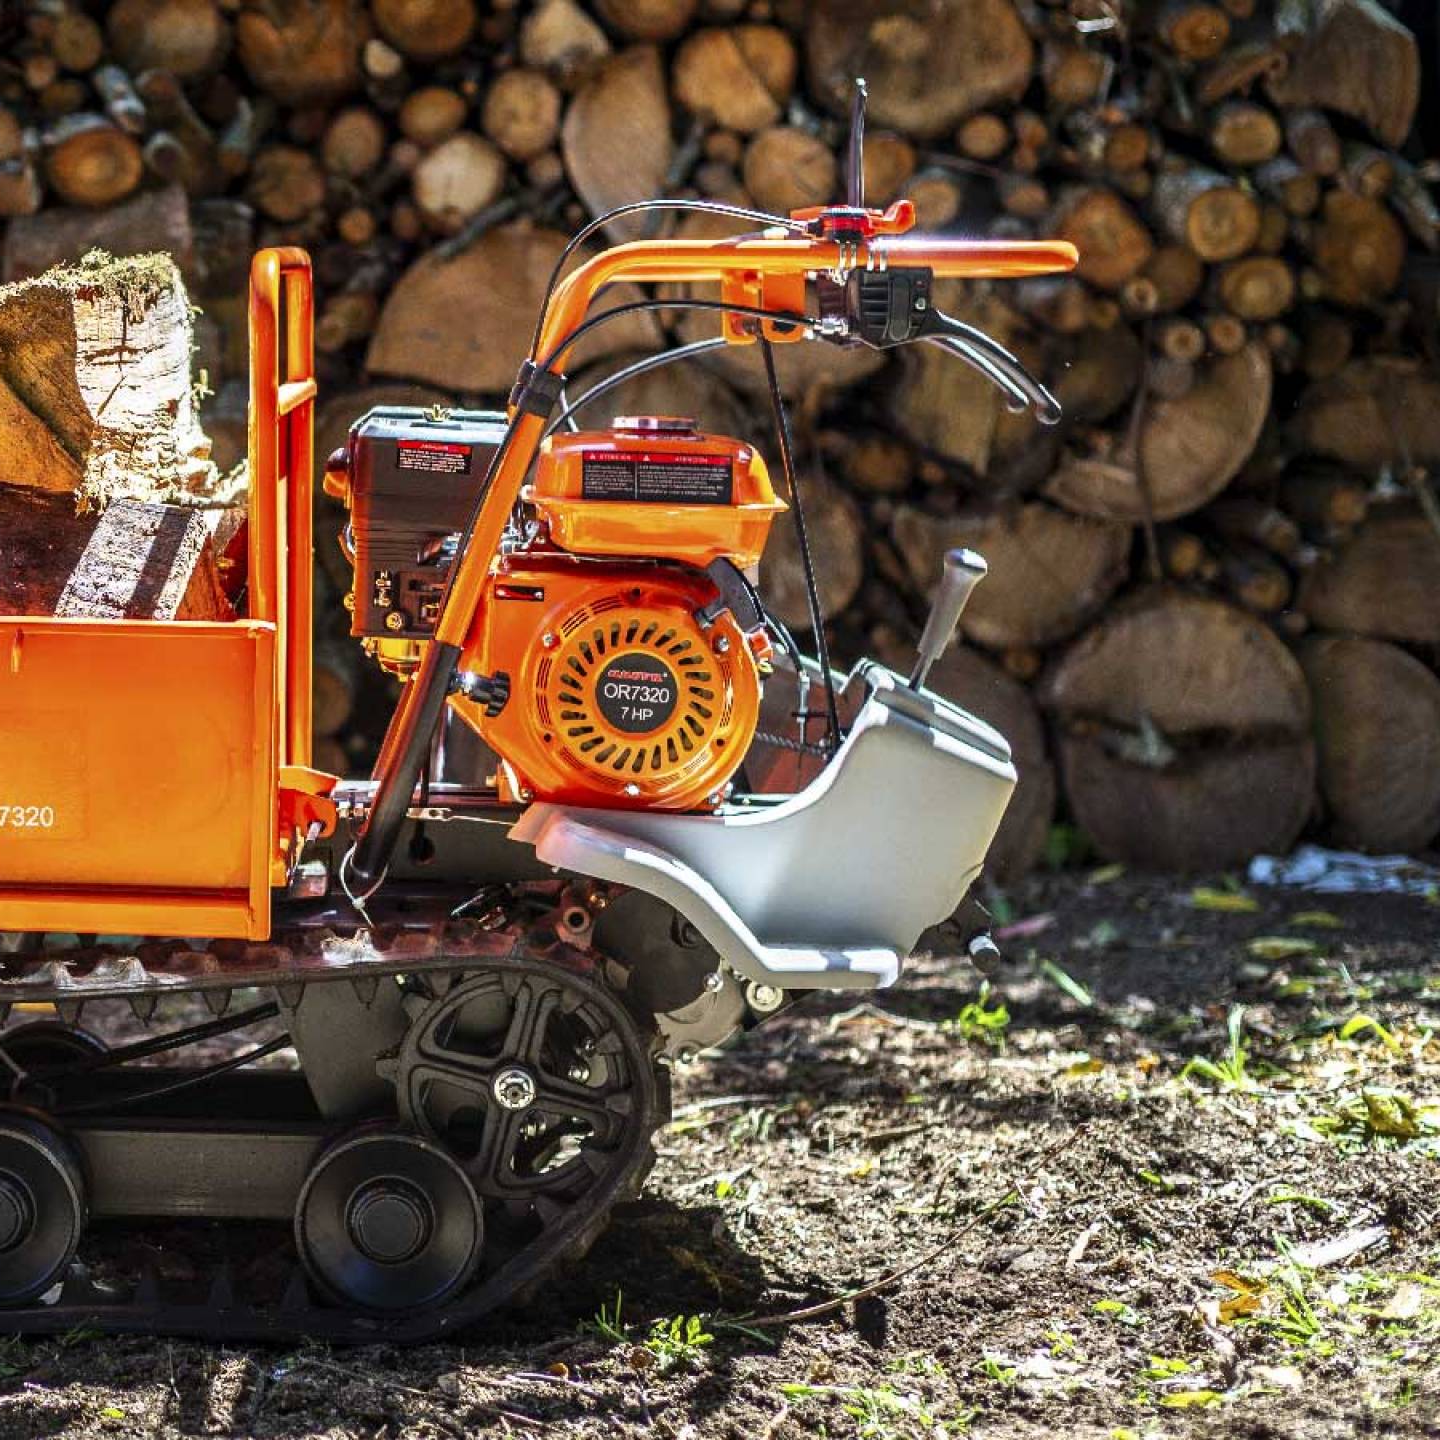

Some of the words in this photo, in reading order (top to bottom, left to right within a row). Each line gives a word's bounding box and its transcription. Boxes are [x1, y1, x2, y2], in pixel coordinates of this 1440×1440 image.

[604, 683, 670, 703] OR7320
[620, 706, 630, 720] 7
[631, 706, 654, 721] HP
